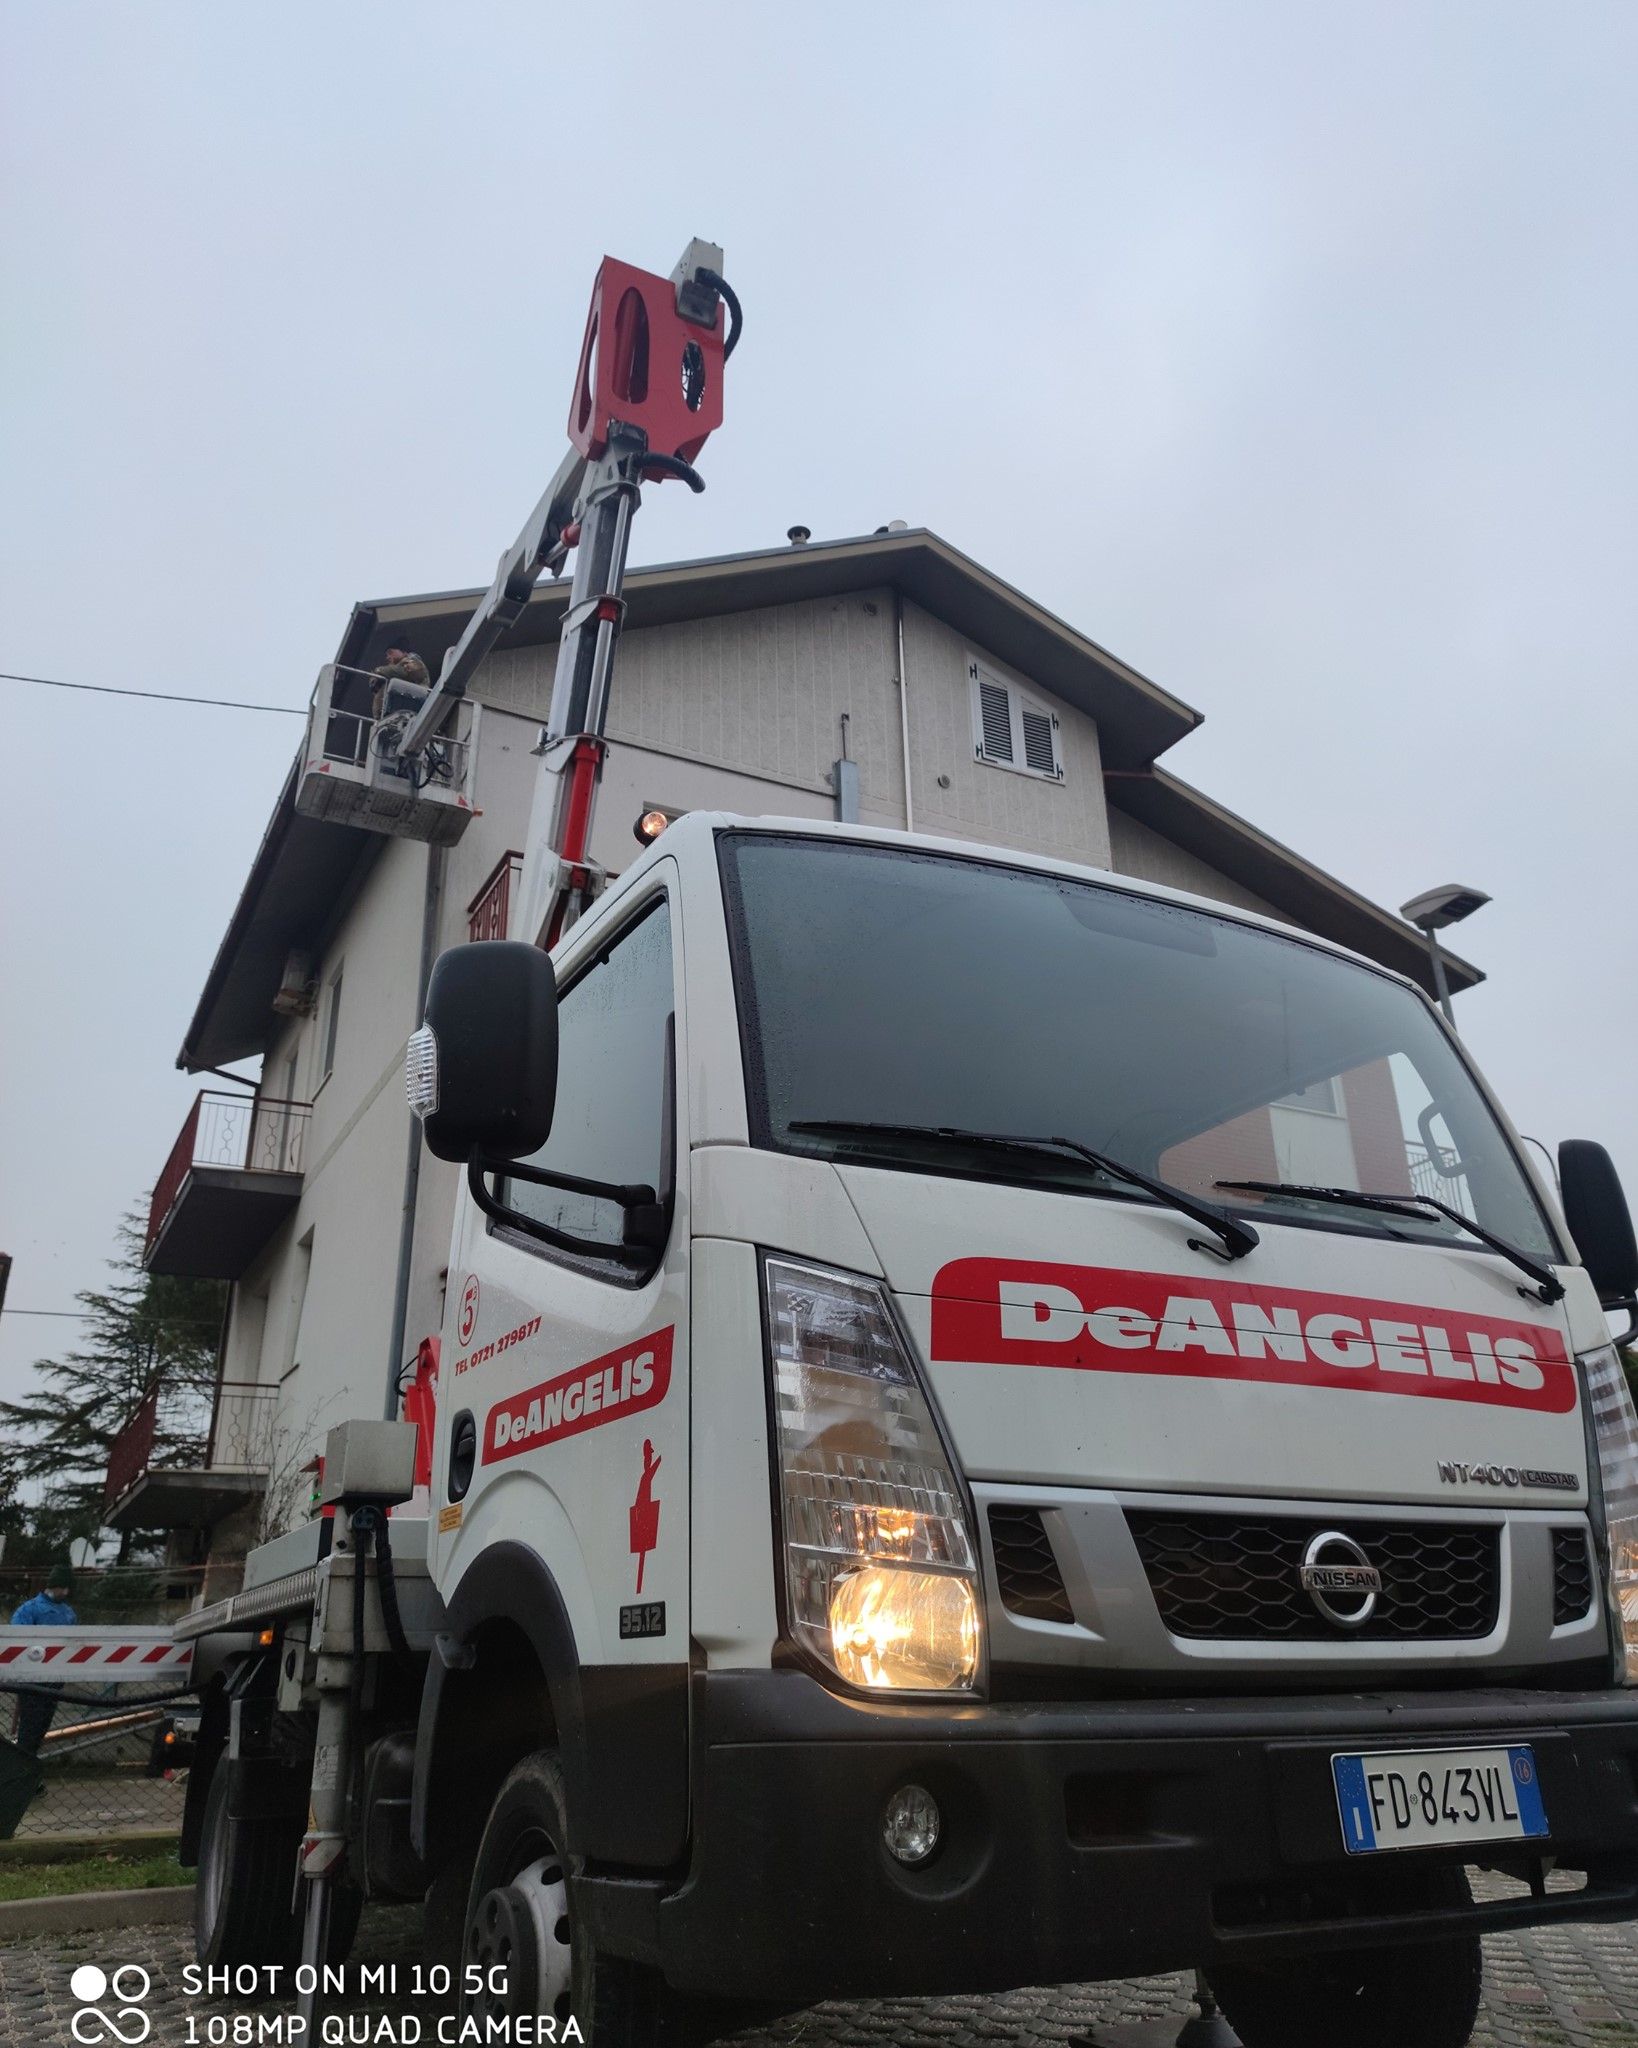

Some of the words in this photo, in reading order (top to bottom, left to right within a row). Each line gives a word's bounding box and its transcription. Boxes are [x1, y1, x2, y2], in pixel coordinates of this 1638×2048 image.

[455, 1358, 468, 1376] TEL
[470, 1341, 495, 1368] 0721
[497, 1316, 542, 1354] 279877
[998, 1280, 1545, 1390] DeANGELIS
[493, 1351, 655, 1450] DeANGELIS
[1437, 1460, 1520, 1487] NT400
[1525, 1470, 1578, 1486] CABSTAR
[1313, 1571, 1377, 1586] NISSAN
